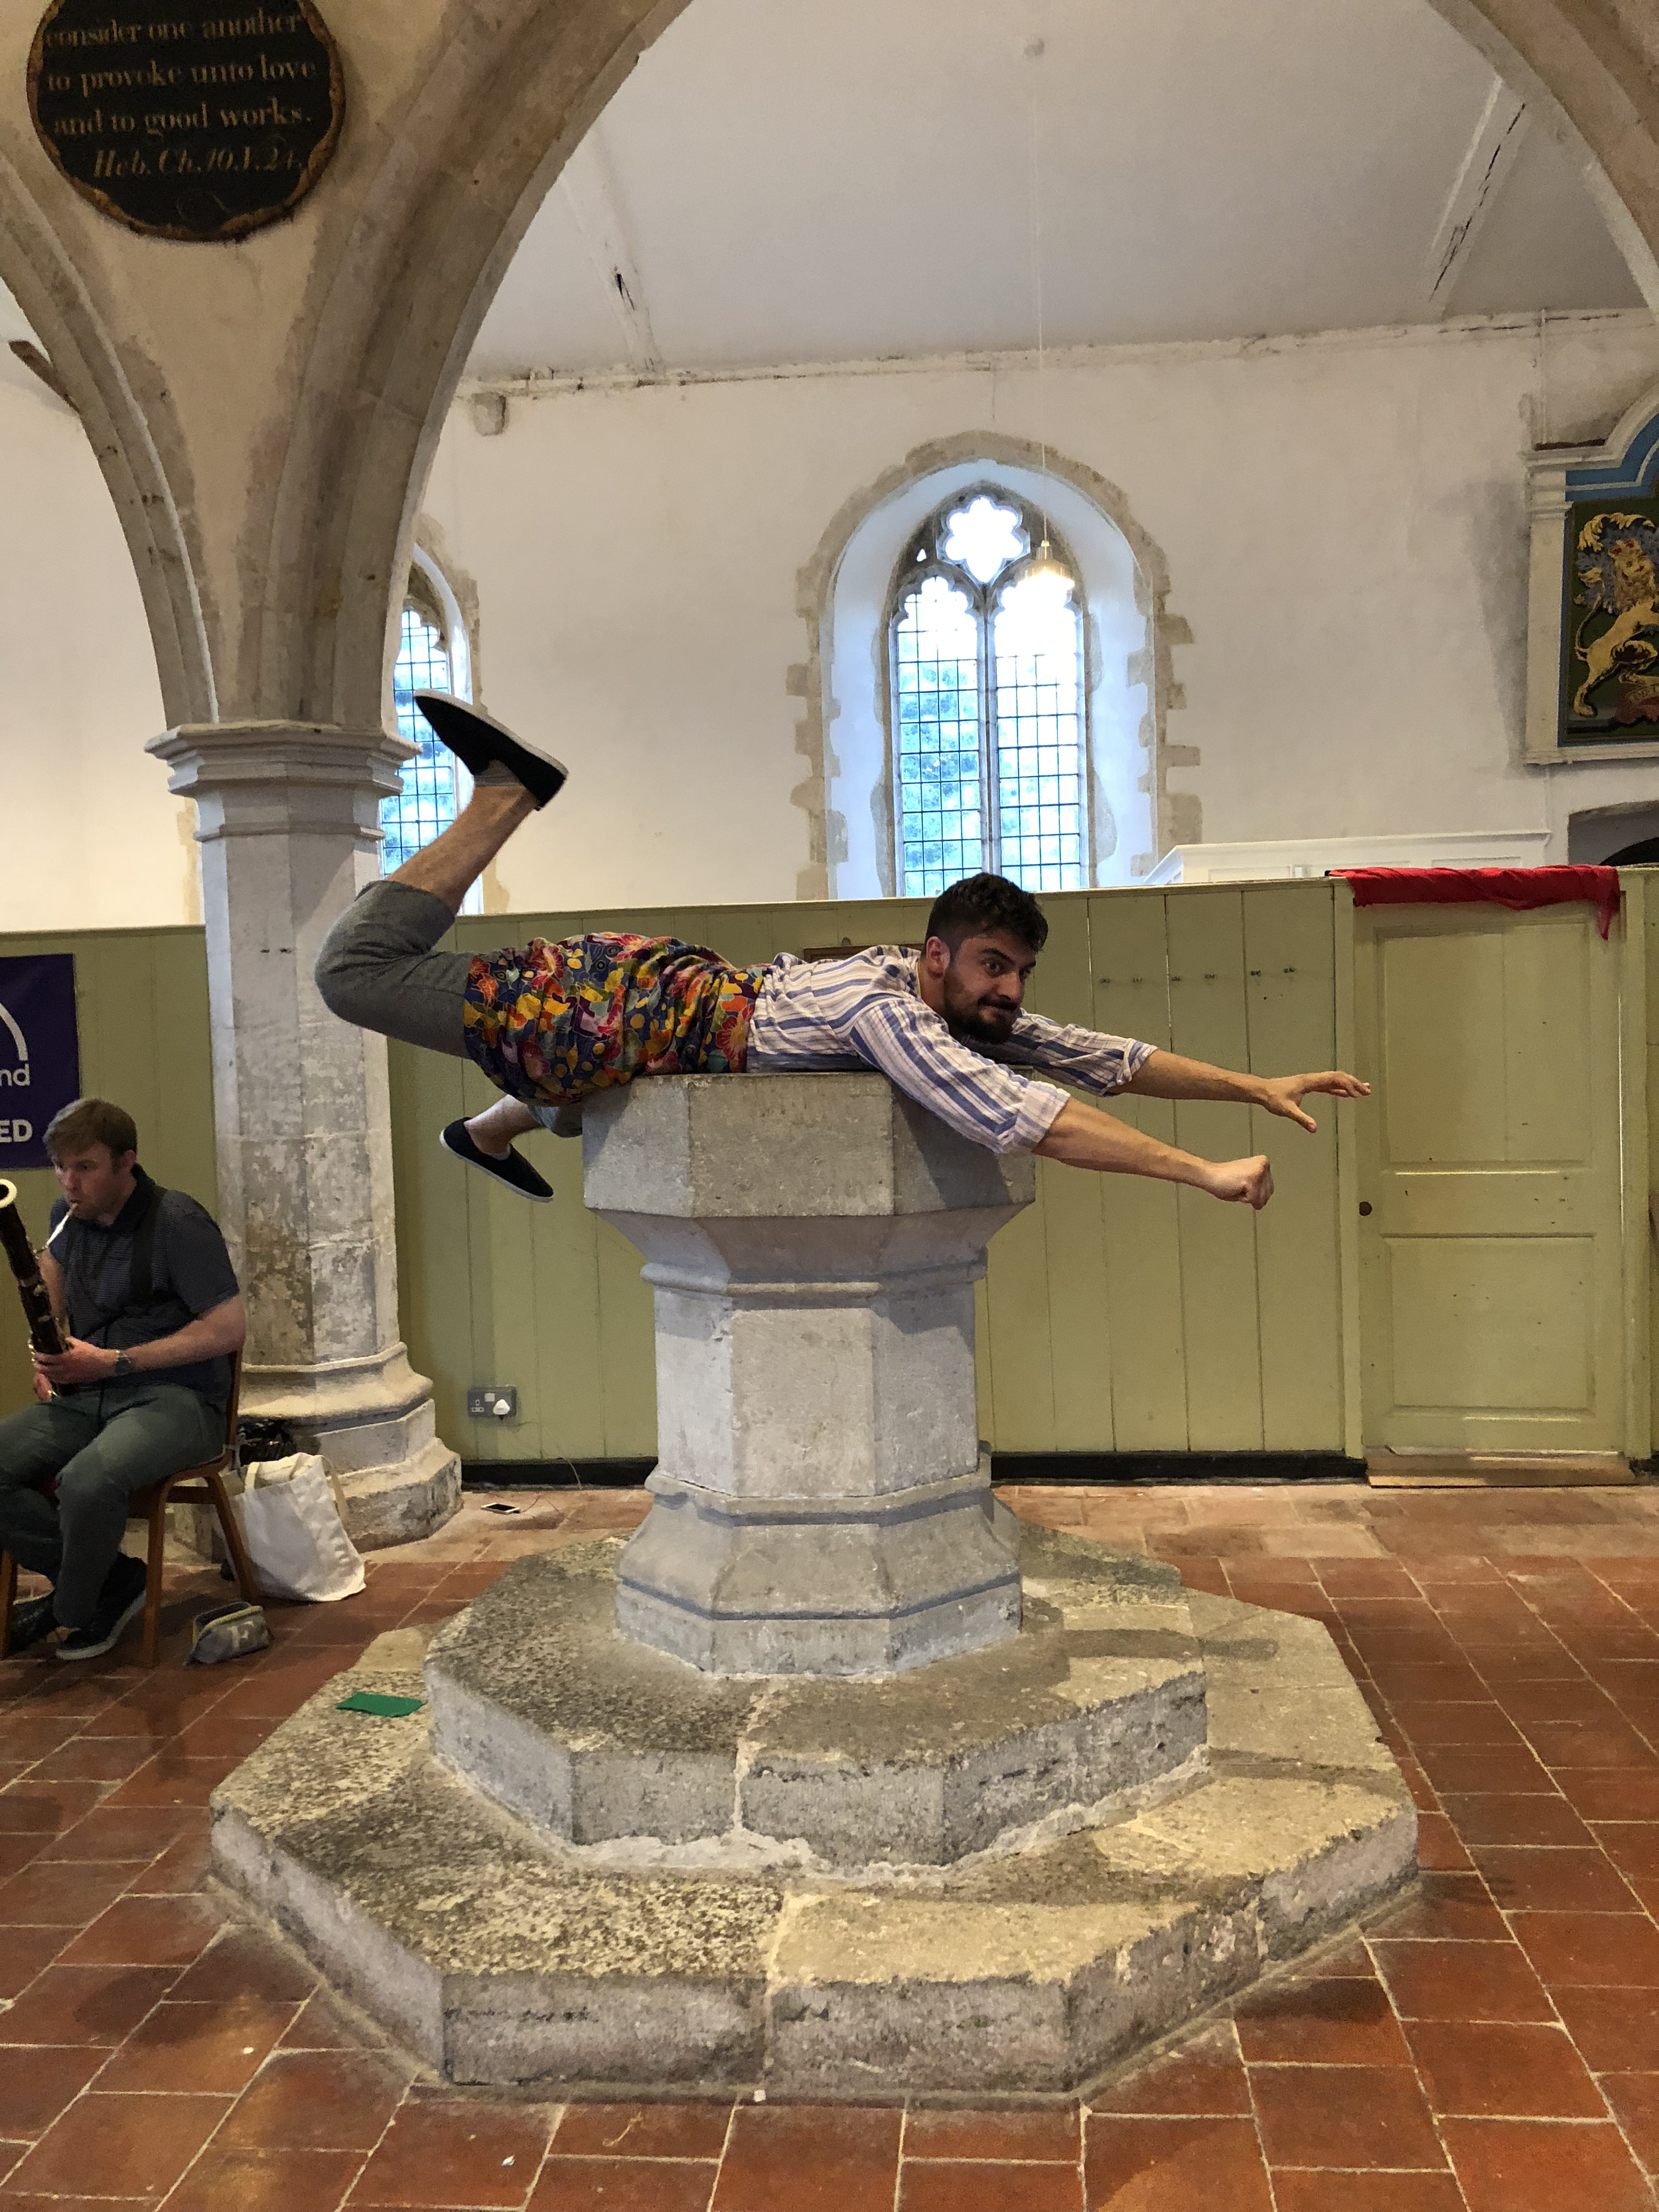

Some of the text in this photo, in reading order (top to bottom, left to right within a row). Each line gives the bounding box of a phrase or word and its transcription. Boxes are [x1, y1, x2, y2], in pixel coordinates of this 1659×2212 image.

[149, 22, 189, 40] one
[202, 8, 301, 39] another
[48, 54, 316, 98] to provoke unto love
[54, 108, 102, 135] and
[111, 114, 135, 131] to
[144, 102, 208, 138] good
